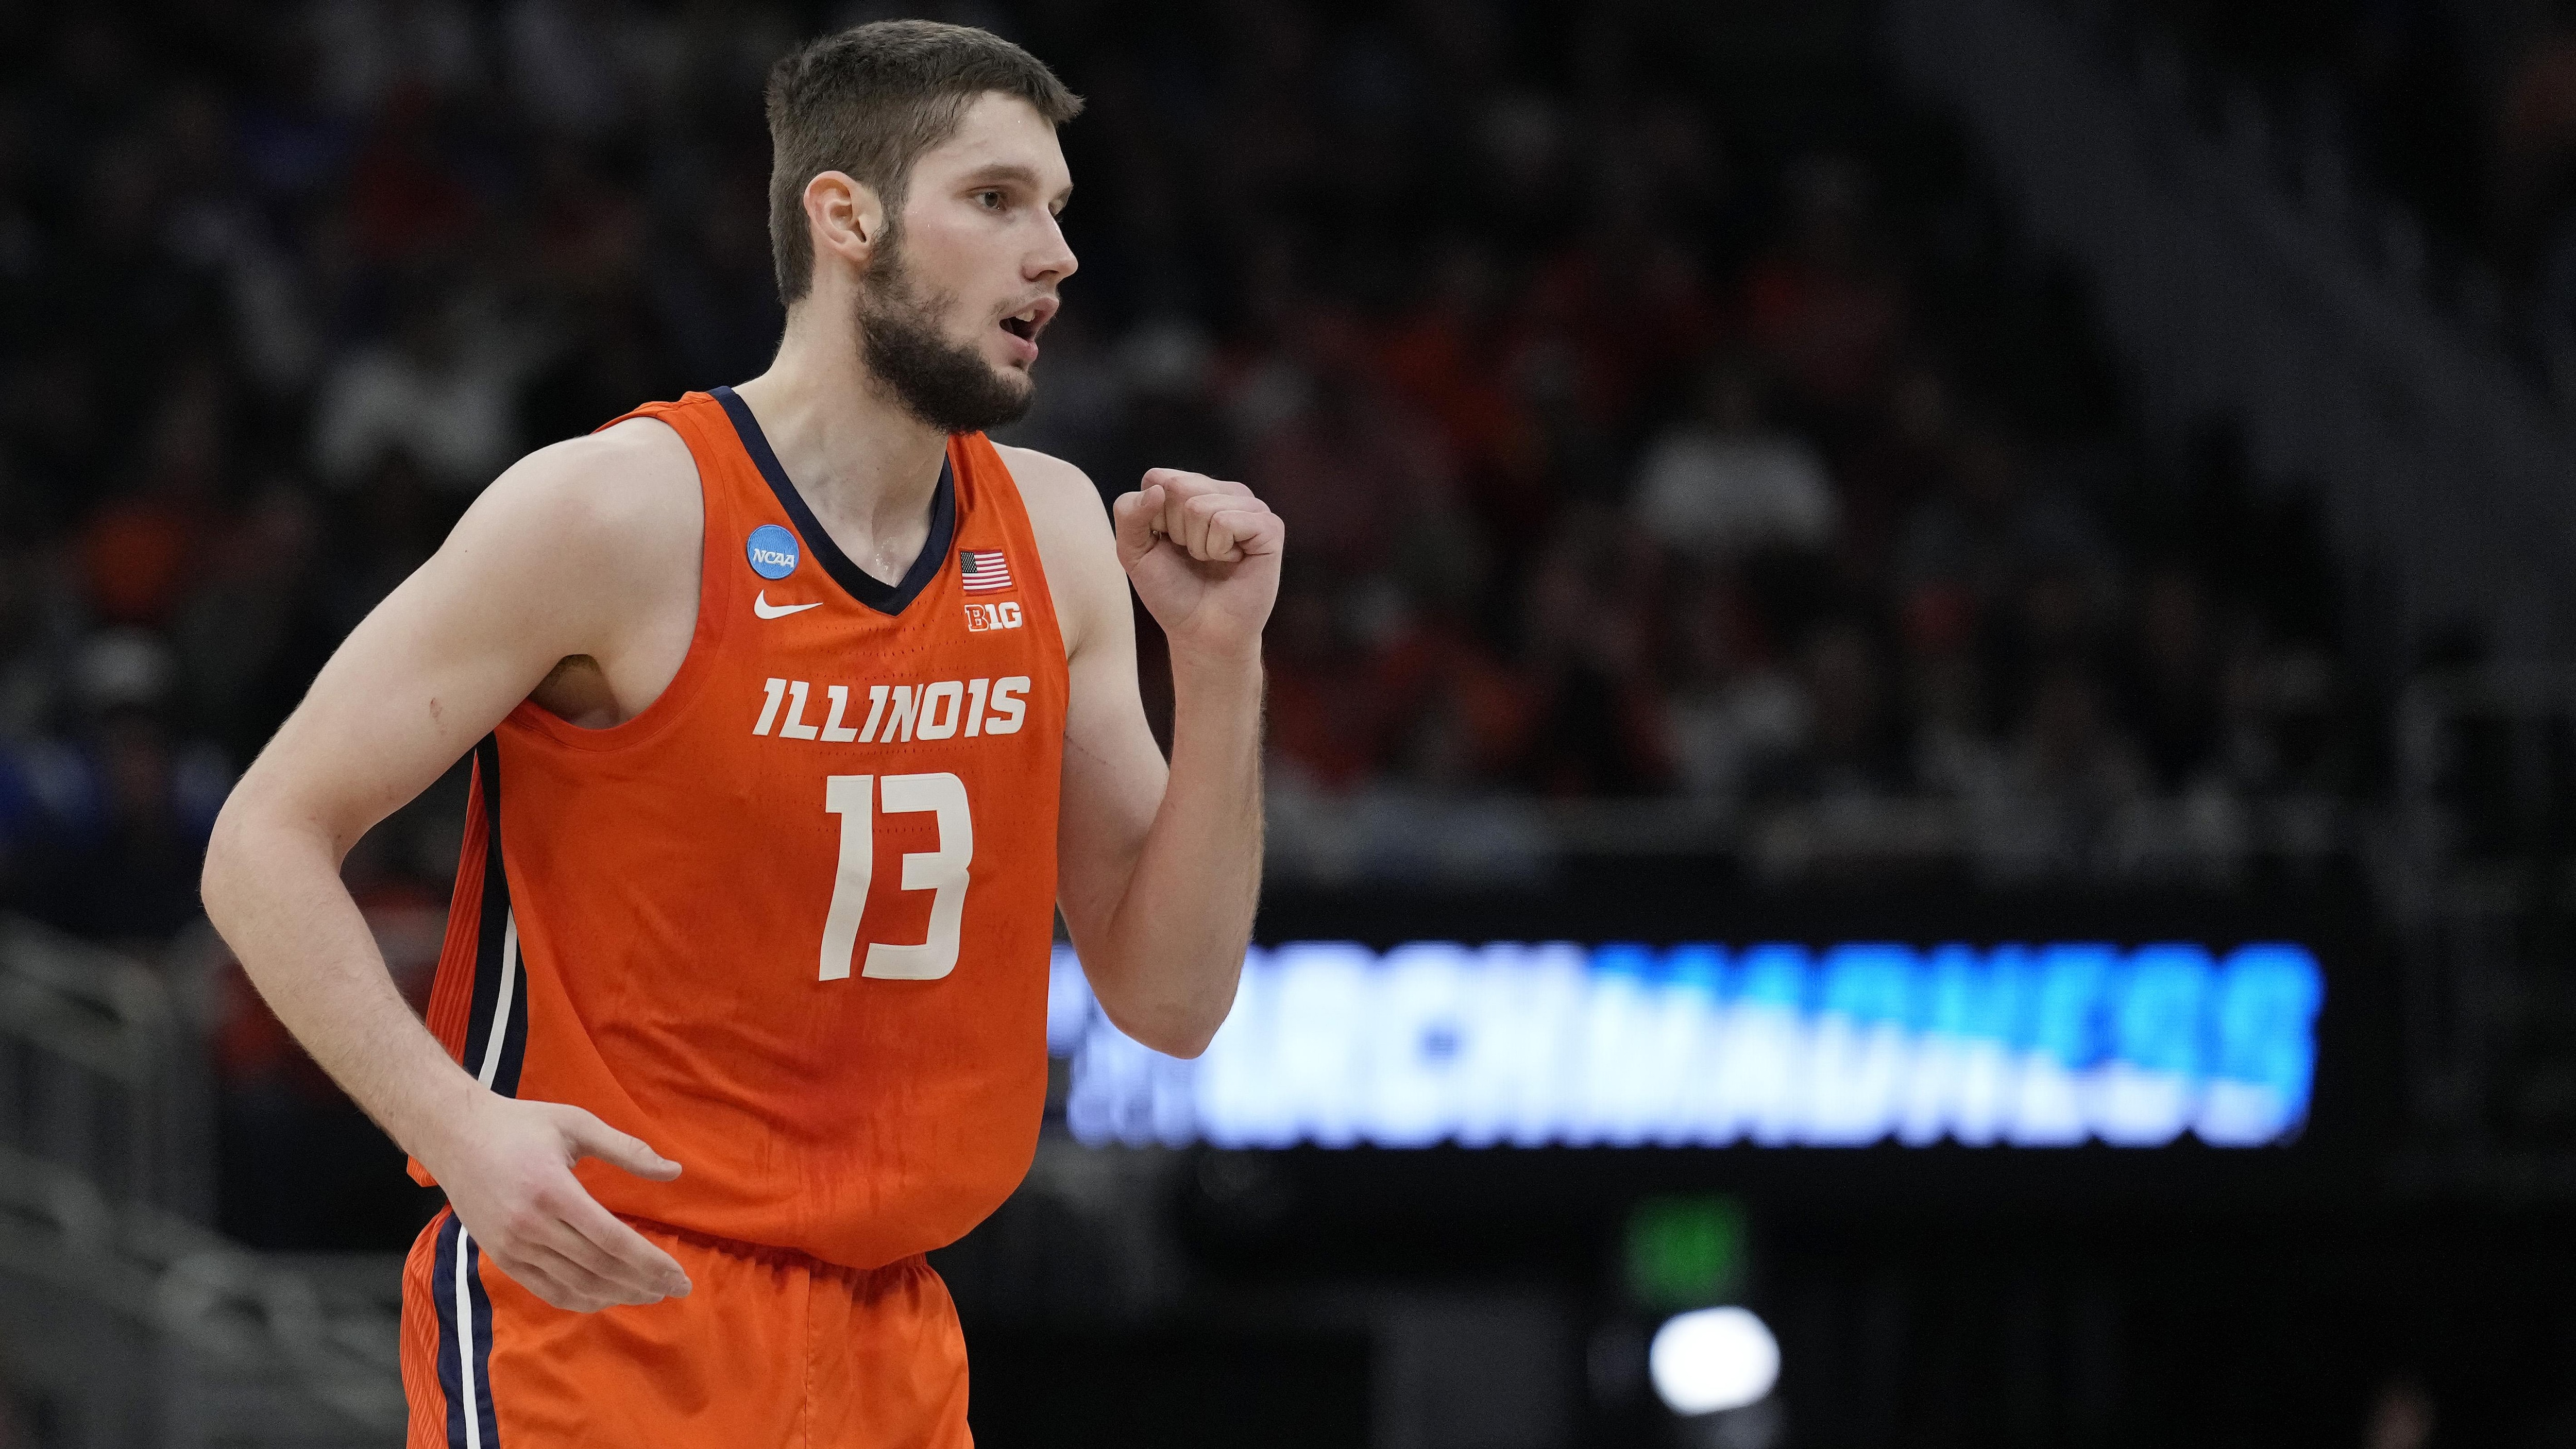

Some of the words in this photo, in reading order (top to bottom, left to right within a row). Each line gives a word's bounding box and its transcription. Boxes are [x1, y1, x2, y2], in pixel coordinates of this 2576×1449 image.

[753, 548, 794, 569] NCAA
[752, 675, 1031, 743] ILLINOIS
[818, 772, 973, 981] 13
